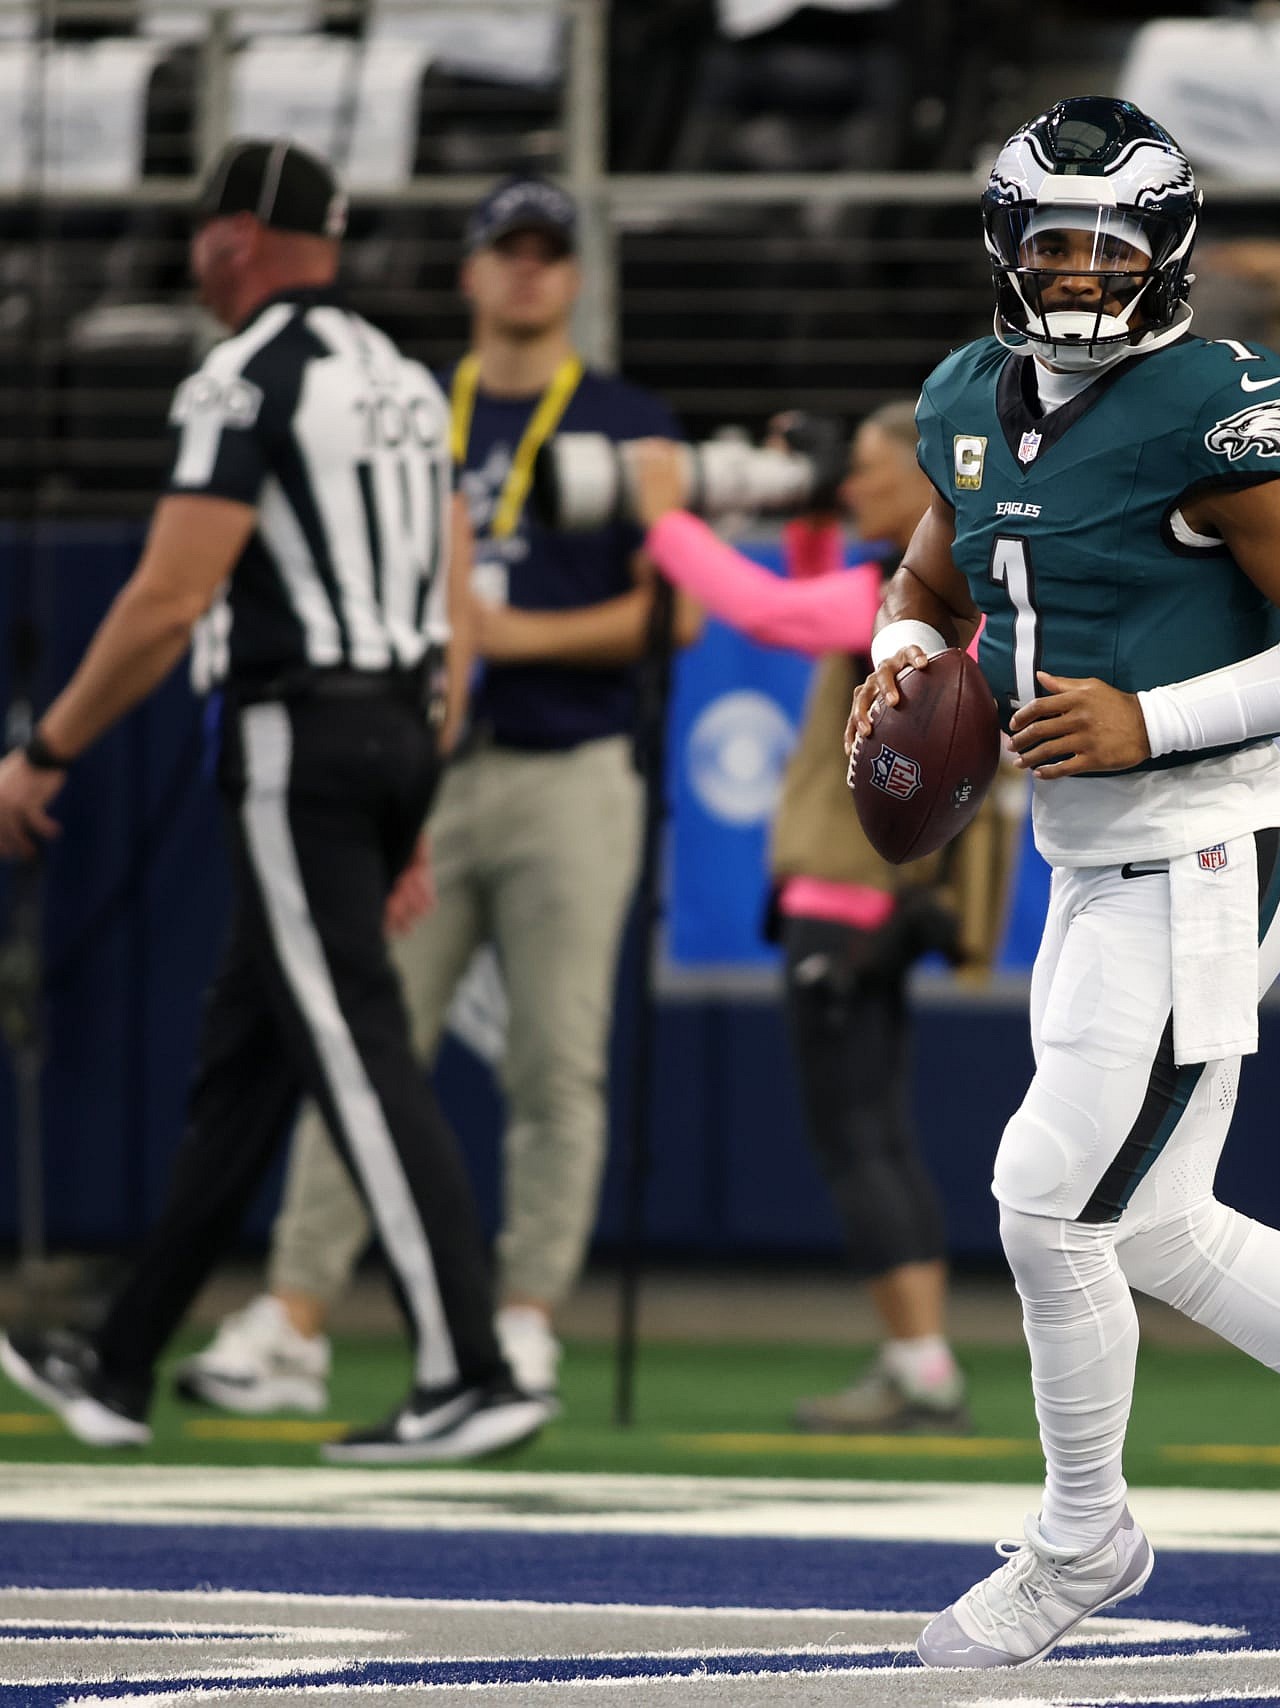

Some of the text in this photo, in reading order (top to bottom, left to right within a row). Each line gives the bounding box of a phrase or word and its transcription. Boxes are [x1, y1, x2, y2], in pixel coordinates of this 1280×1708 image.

[956, 440, 982, 476] C
[1020, 444, 1036, 461] NFL
[995, 501, 1042, 518] EAGLES
[990, 537, 1038, 708] 1
[886, 762, 917, 797] NFL
[1200, 850, 1225, 869] NFL
